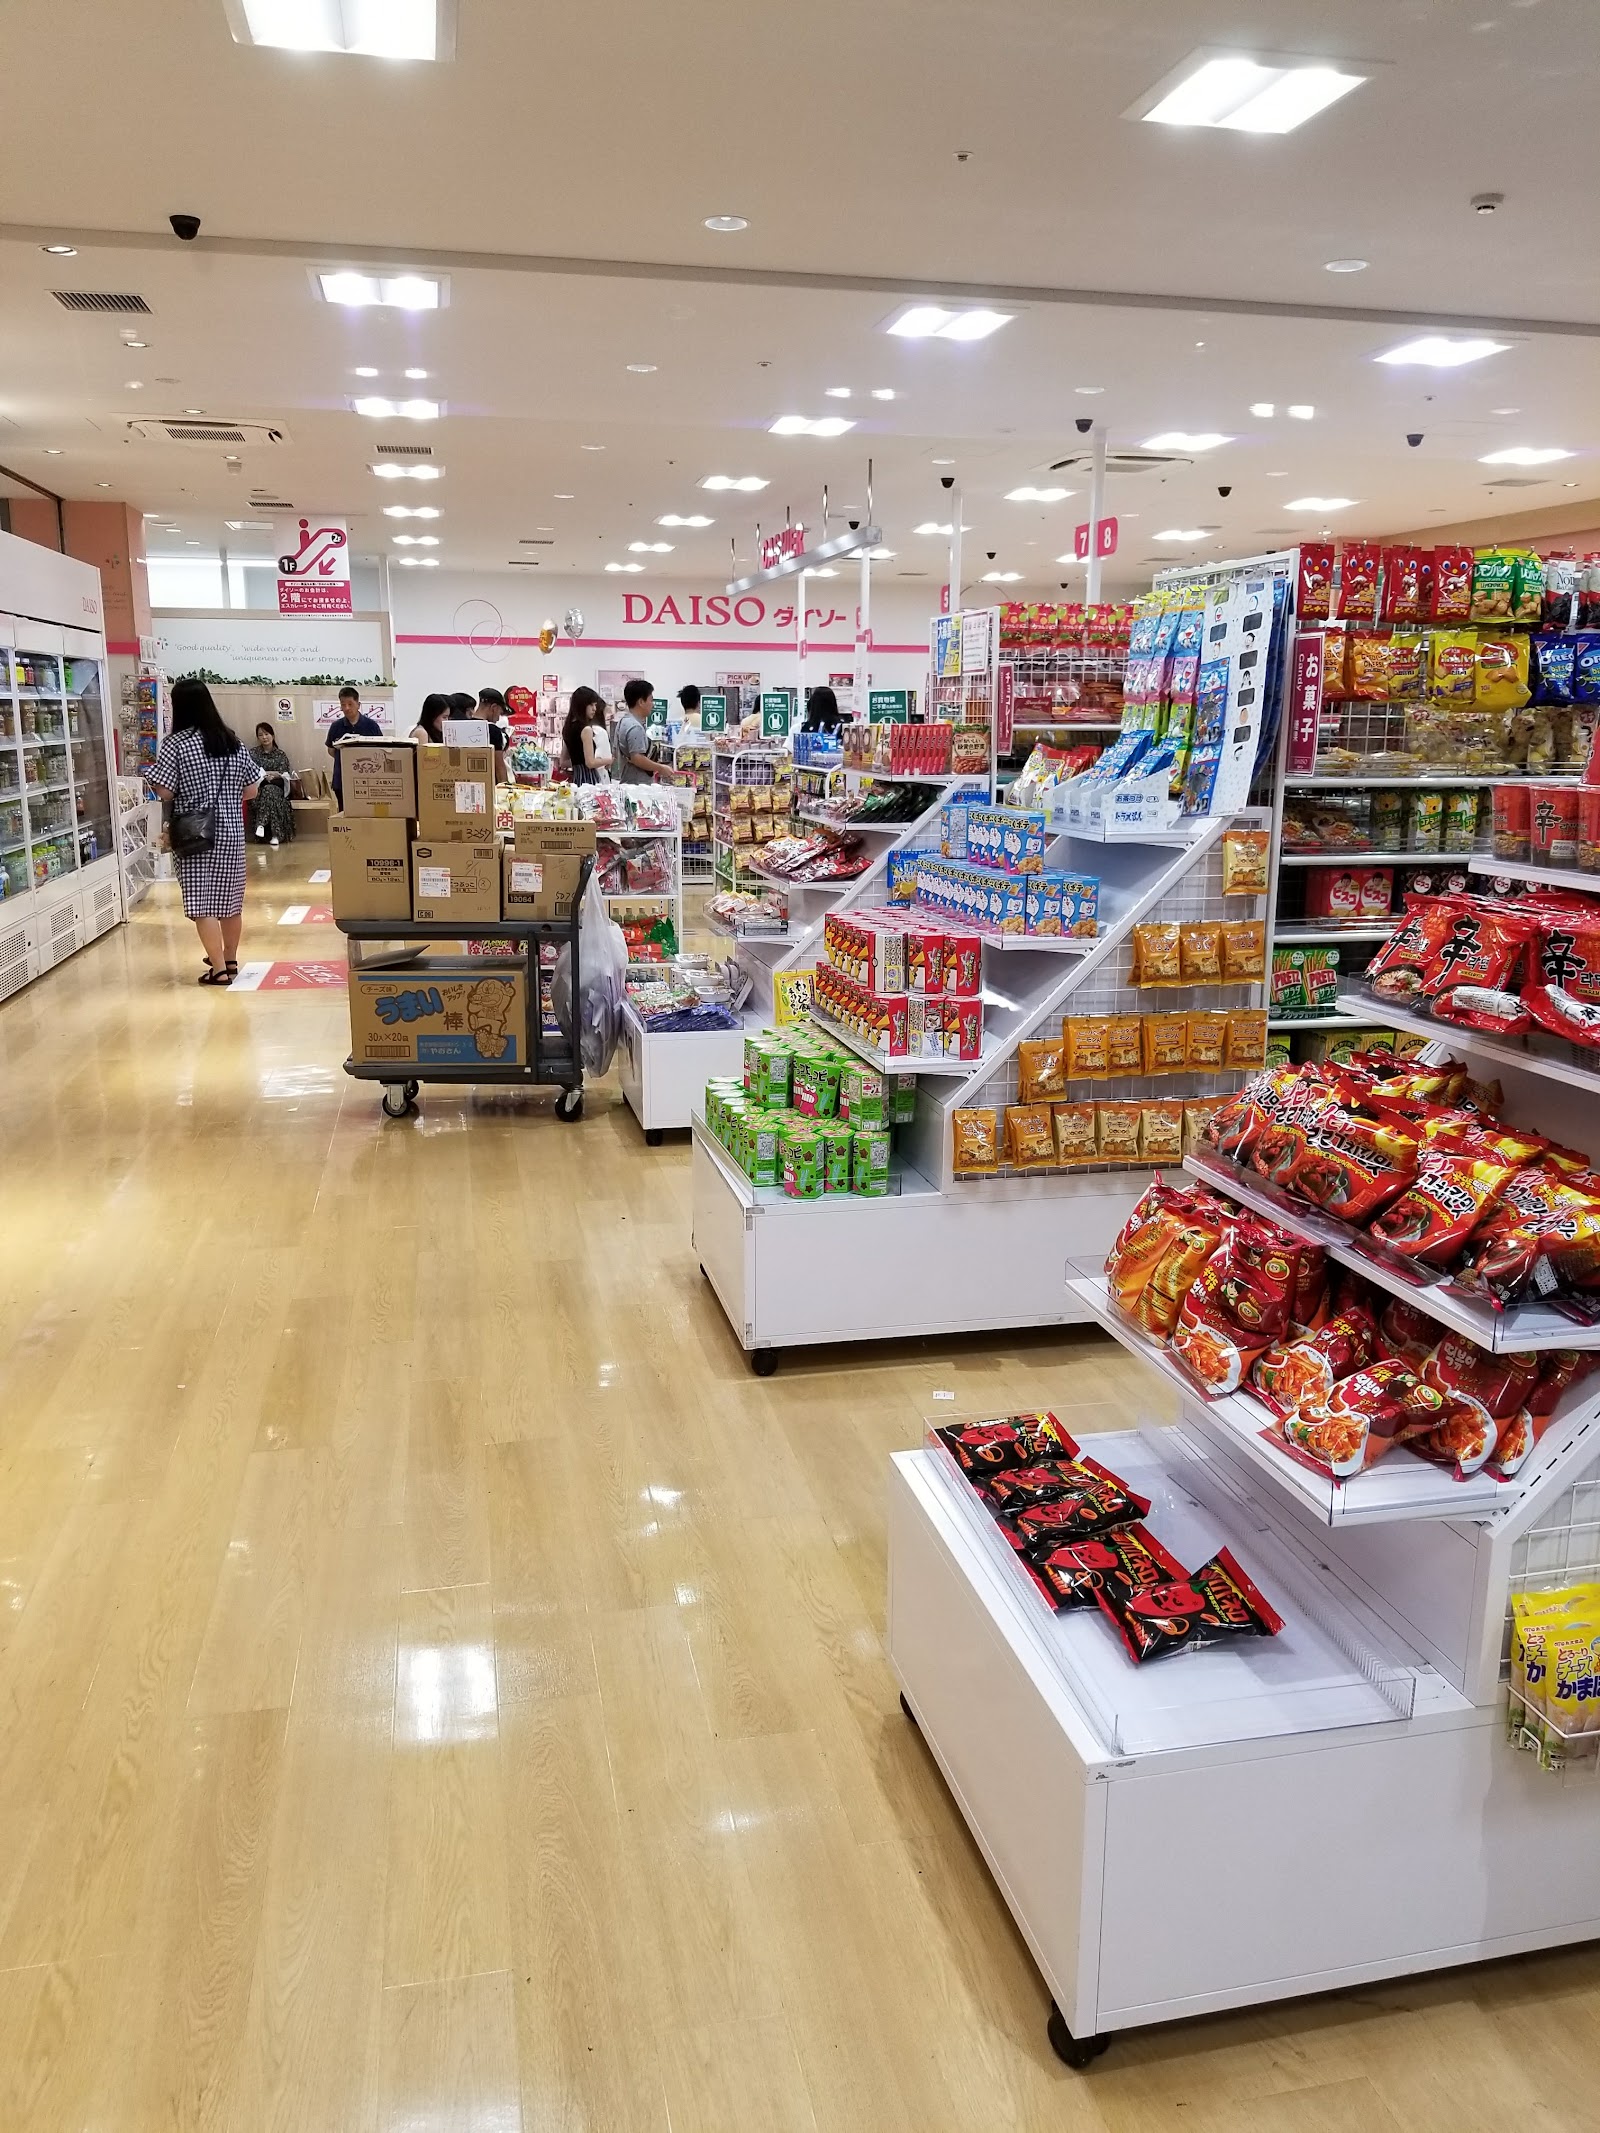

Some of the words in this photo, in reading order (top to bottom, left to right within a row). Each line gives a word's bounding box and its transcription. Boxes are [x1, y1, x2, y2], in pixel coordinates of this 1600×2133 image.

[333, 534, 342, 543] 2F
[1080, 532, 1088, 553] 7
[1103, 527, 1112, 548] 8
[282, 558, 295, 572] 1F
[622, 593, 765, 627] DAISO
[1541, 652, 1575, 665] OREO
[1296, 653, 1305, 692] Candy
[1004, 672, 1013, 738] チョコレート
[1300, 653, 1319, 743] お菓子
[1333, 888, 1356, 905] ビスコ
[1364, 888, 1389, 905] ビスコ
[1436, 914, 1483, 987] 辛
[1541, 929, 1587, 989] 辛
[1274, 970, 1301, 988] PRETZ
[1309, 970, 1336, 989] PRETZ
[375, 986, 445, 1025] うまい
[443, 1011, 464, 1031] 棒
[1444, 1342, 1477, 1371] 떡볶이
[1354, 1373, 1384, 1397] 떡볶이
[1556, 1656, 1593, 1681] チーズ
